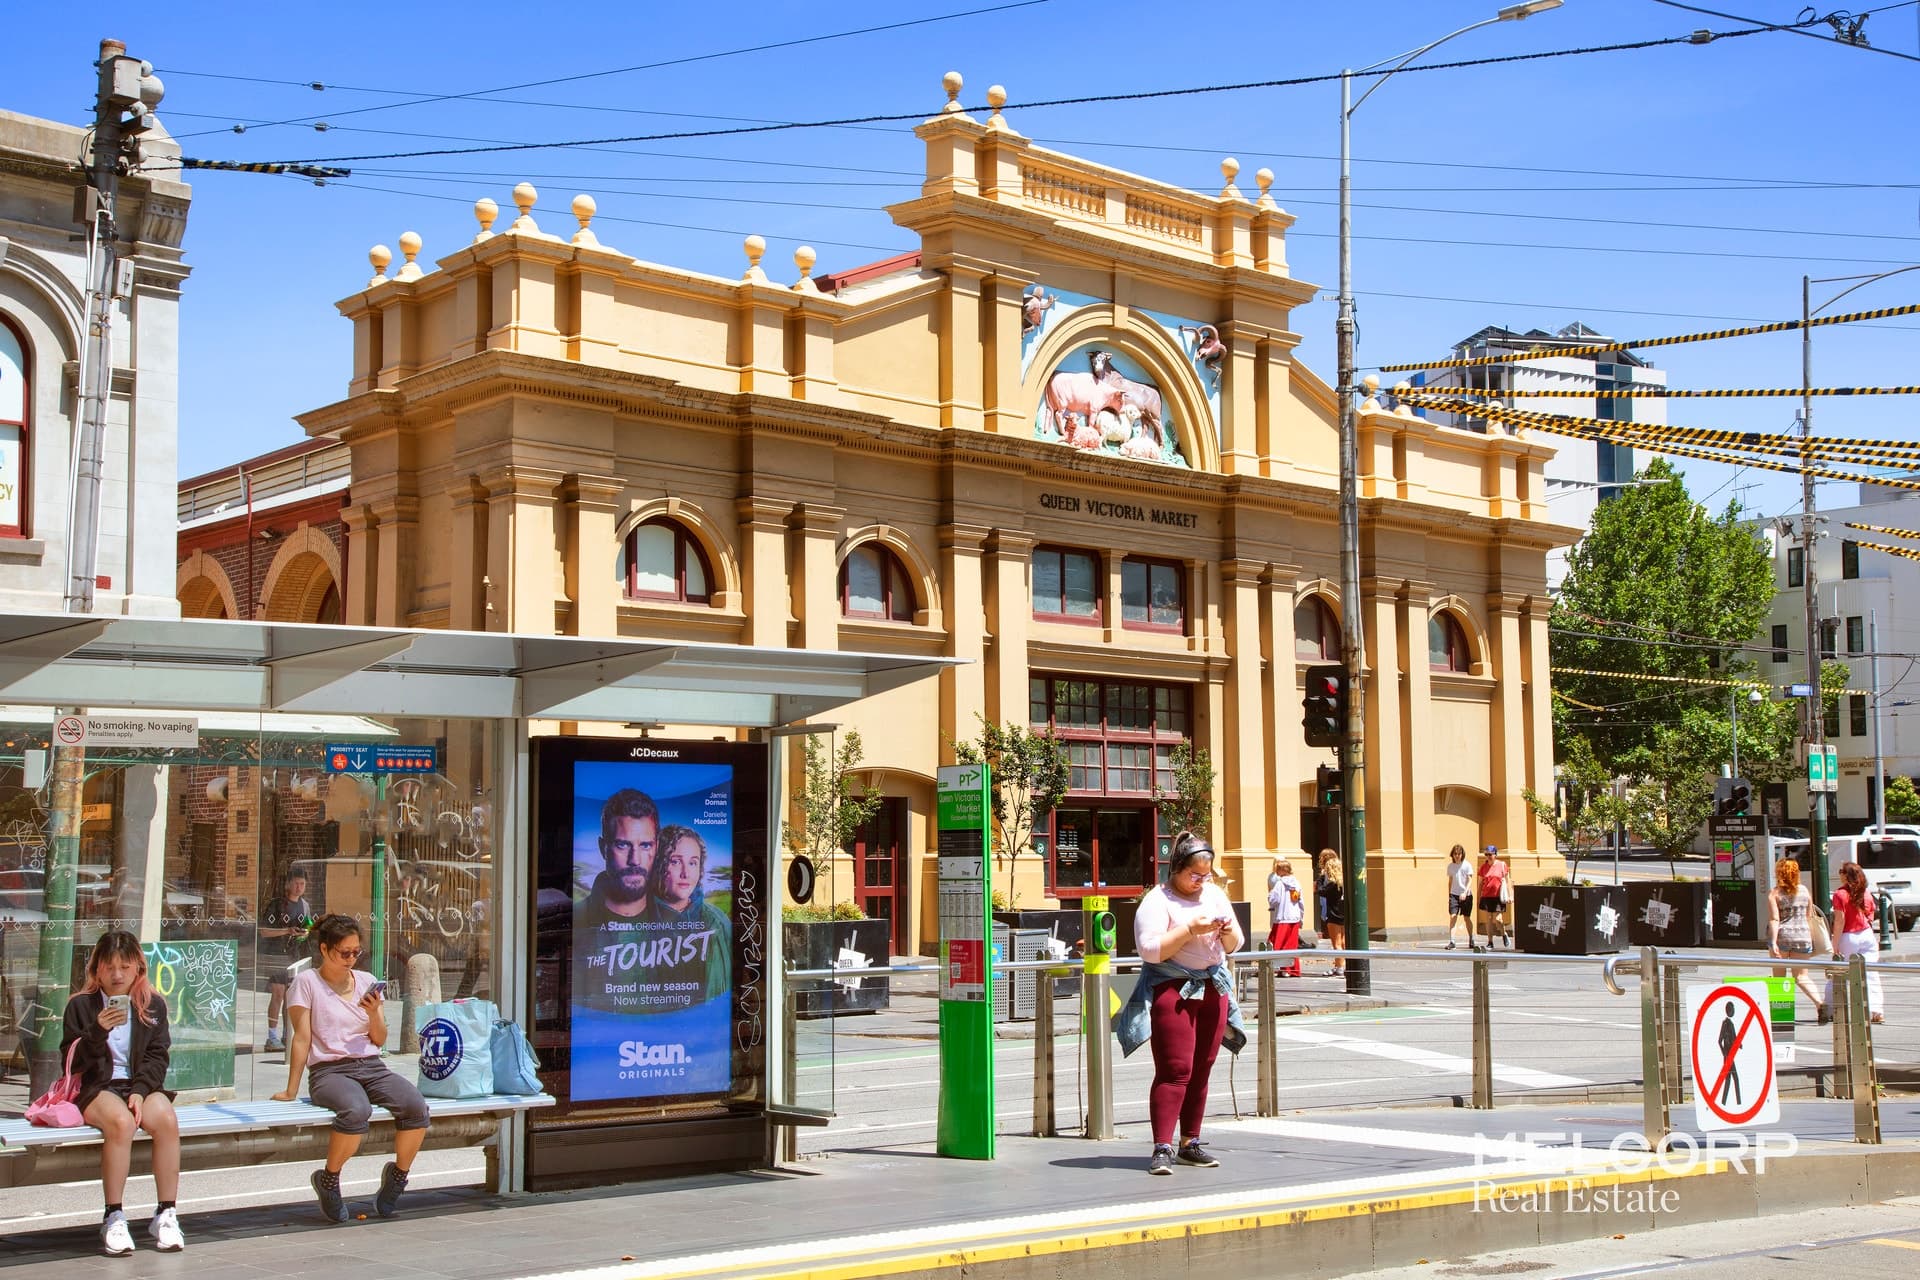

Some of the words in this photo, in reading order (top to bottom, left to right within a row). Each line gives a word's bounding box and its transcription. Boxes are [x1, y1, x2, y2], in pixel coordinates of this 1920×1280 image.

[1039, 493, 1080, 512] QUEEN
[1087, 500, 1145, 521] VICTORIA
[1150, 509, 1198, 528] MARKET
[88, 721, 101, 730] No
[103, 721, 146, 732] smoking.
[148, 722, 160, 731] No
[162, 722, 195, 733] vaping.
[630, 748, 679, 758] JCDecaux
[954, 792, 981, 802] Victoria
[956, 804, 981, 813] Market
[703, 811, 727, 819] Danielle
[974, 861, 982, 876] 7
[600, 923, 607, 931] A
[608, 921, 635, 932] Stan.
[636, 921, 676, 931] ORIGINAL
[678, 921, 705, 930] SERIES
[587, 954, 607, 969] THE
[604, 929, 716, 976] TOURIST
[605, 982, 636, 993] Brand
[664, 982, 699, 991] season
[614, 996, 637, 1005] Now
[640, 993, 691, 1005] streaming
[619, 1041, 692, 1067] Stan.
[619, 1068, 685, 1080] ORIGINALS
